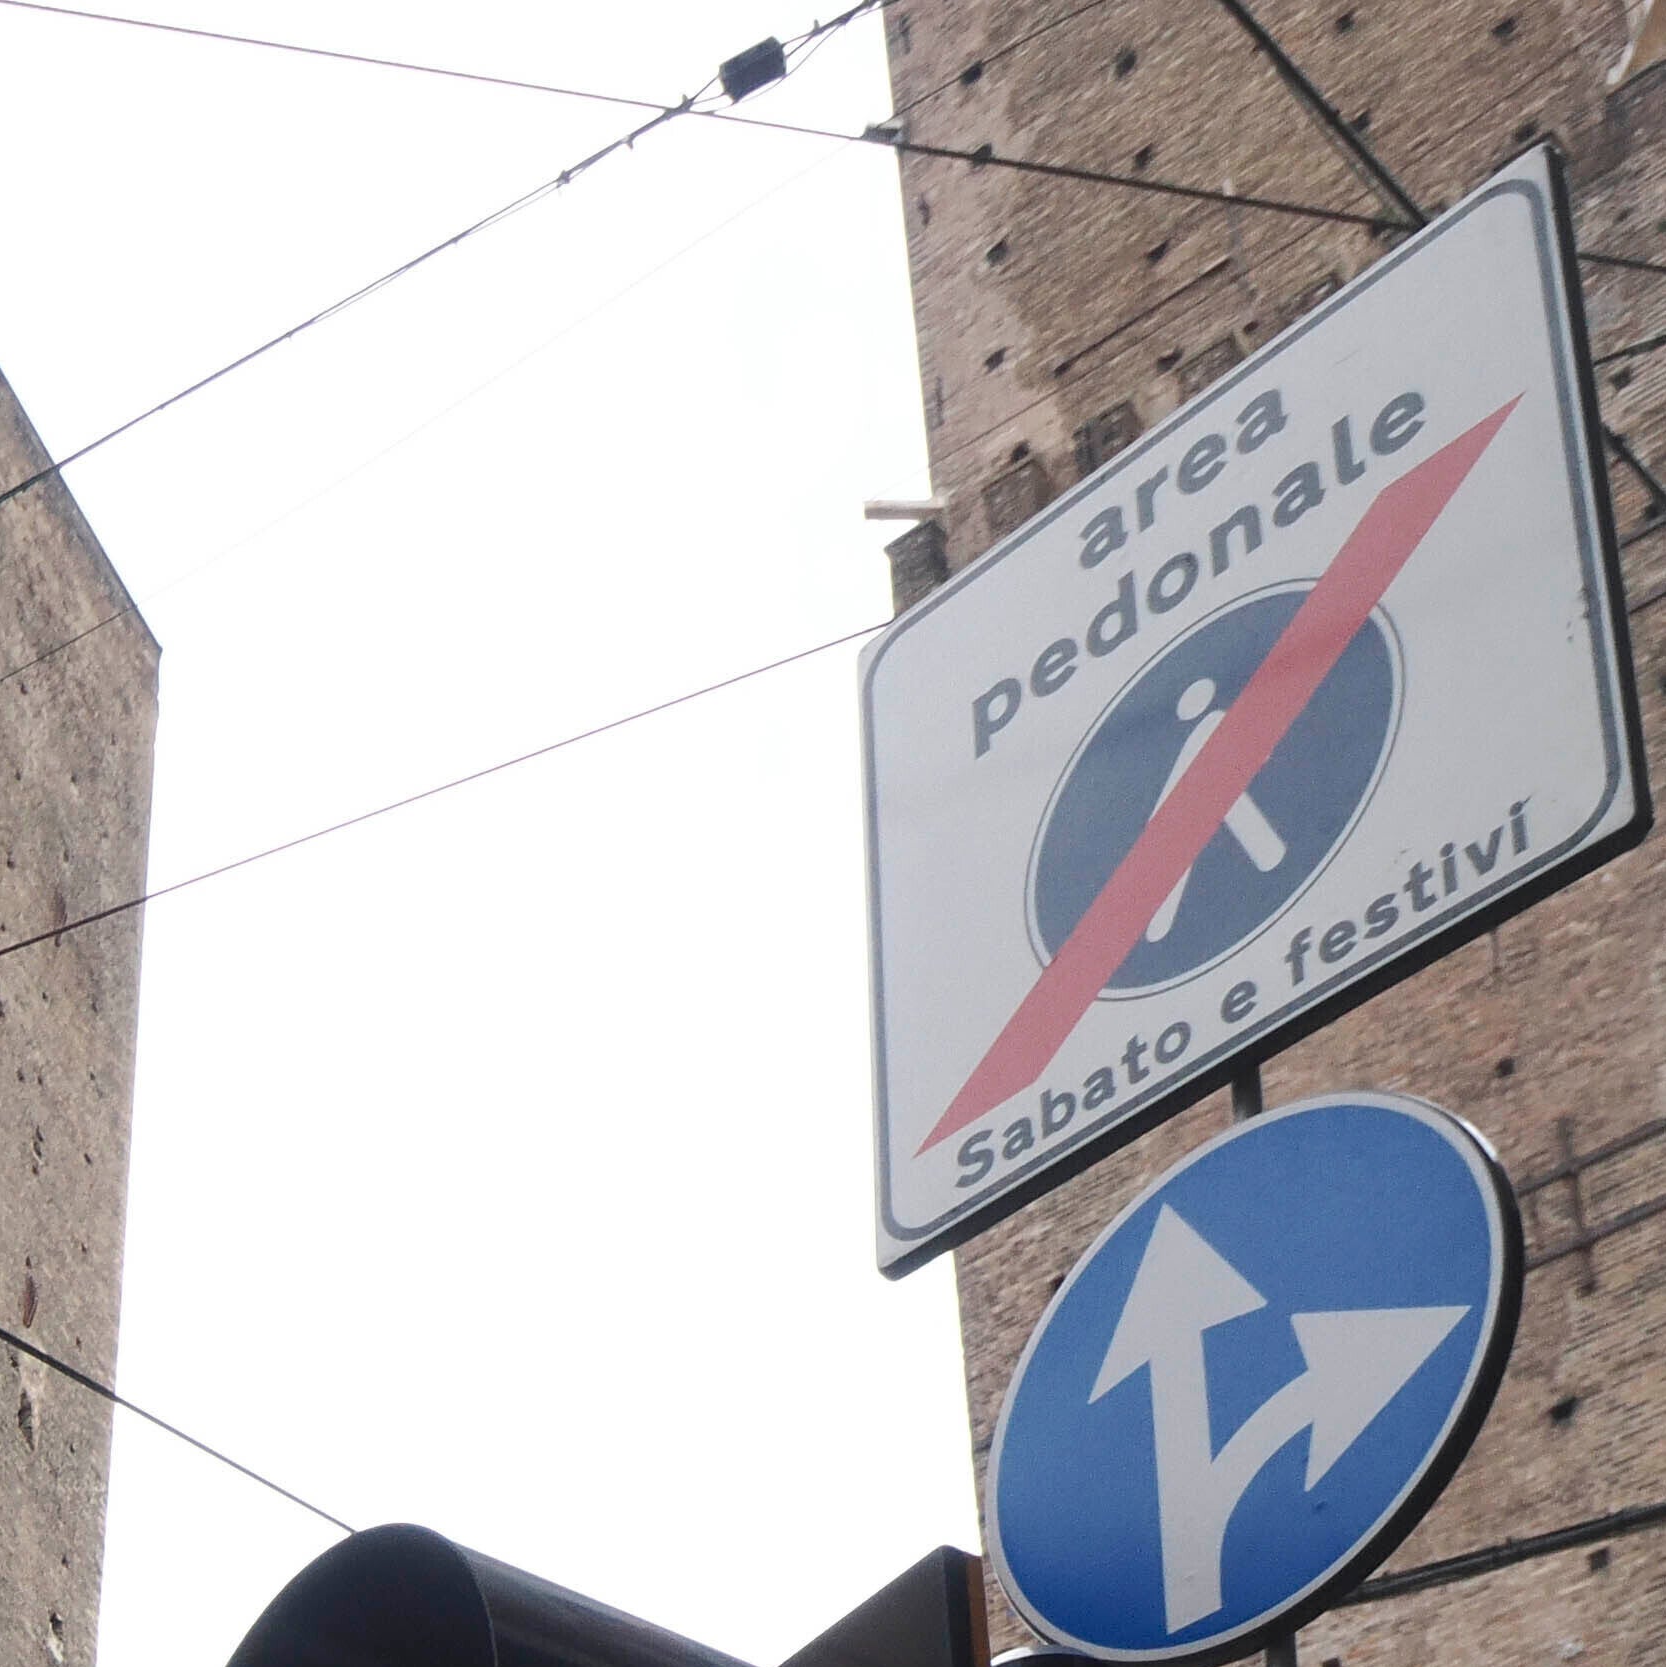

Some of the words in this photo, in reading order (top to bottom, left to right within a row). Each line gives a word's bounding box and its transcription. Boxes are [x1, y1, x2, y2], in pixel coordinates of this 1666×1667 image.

[970, 387, 1430, 762] pedonale
[1076, 385, 1291, 570] area
[954, 1005, 1195, 1191] Sabato
[1219, 975, 1259, 1023] e
[1281, 795, 1534, 985] festivi
